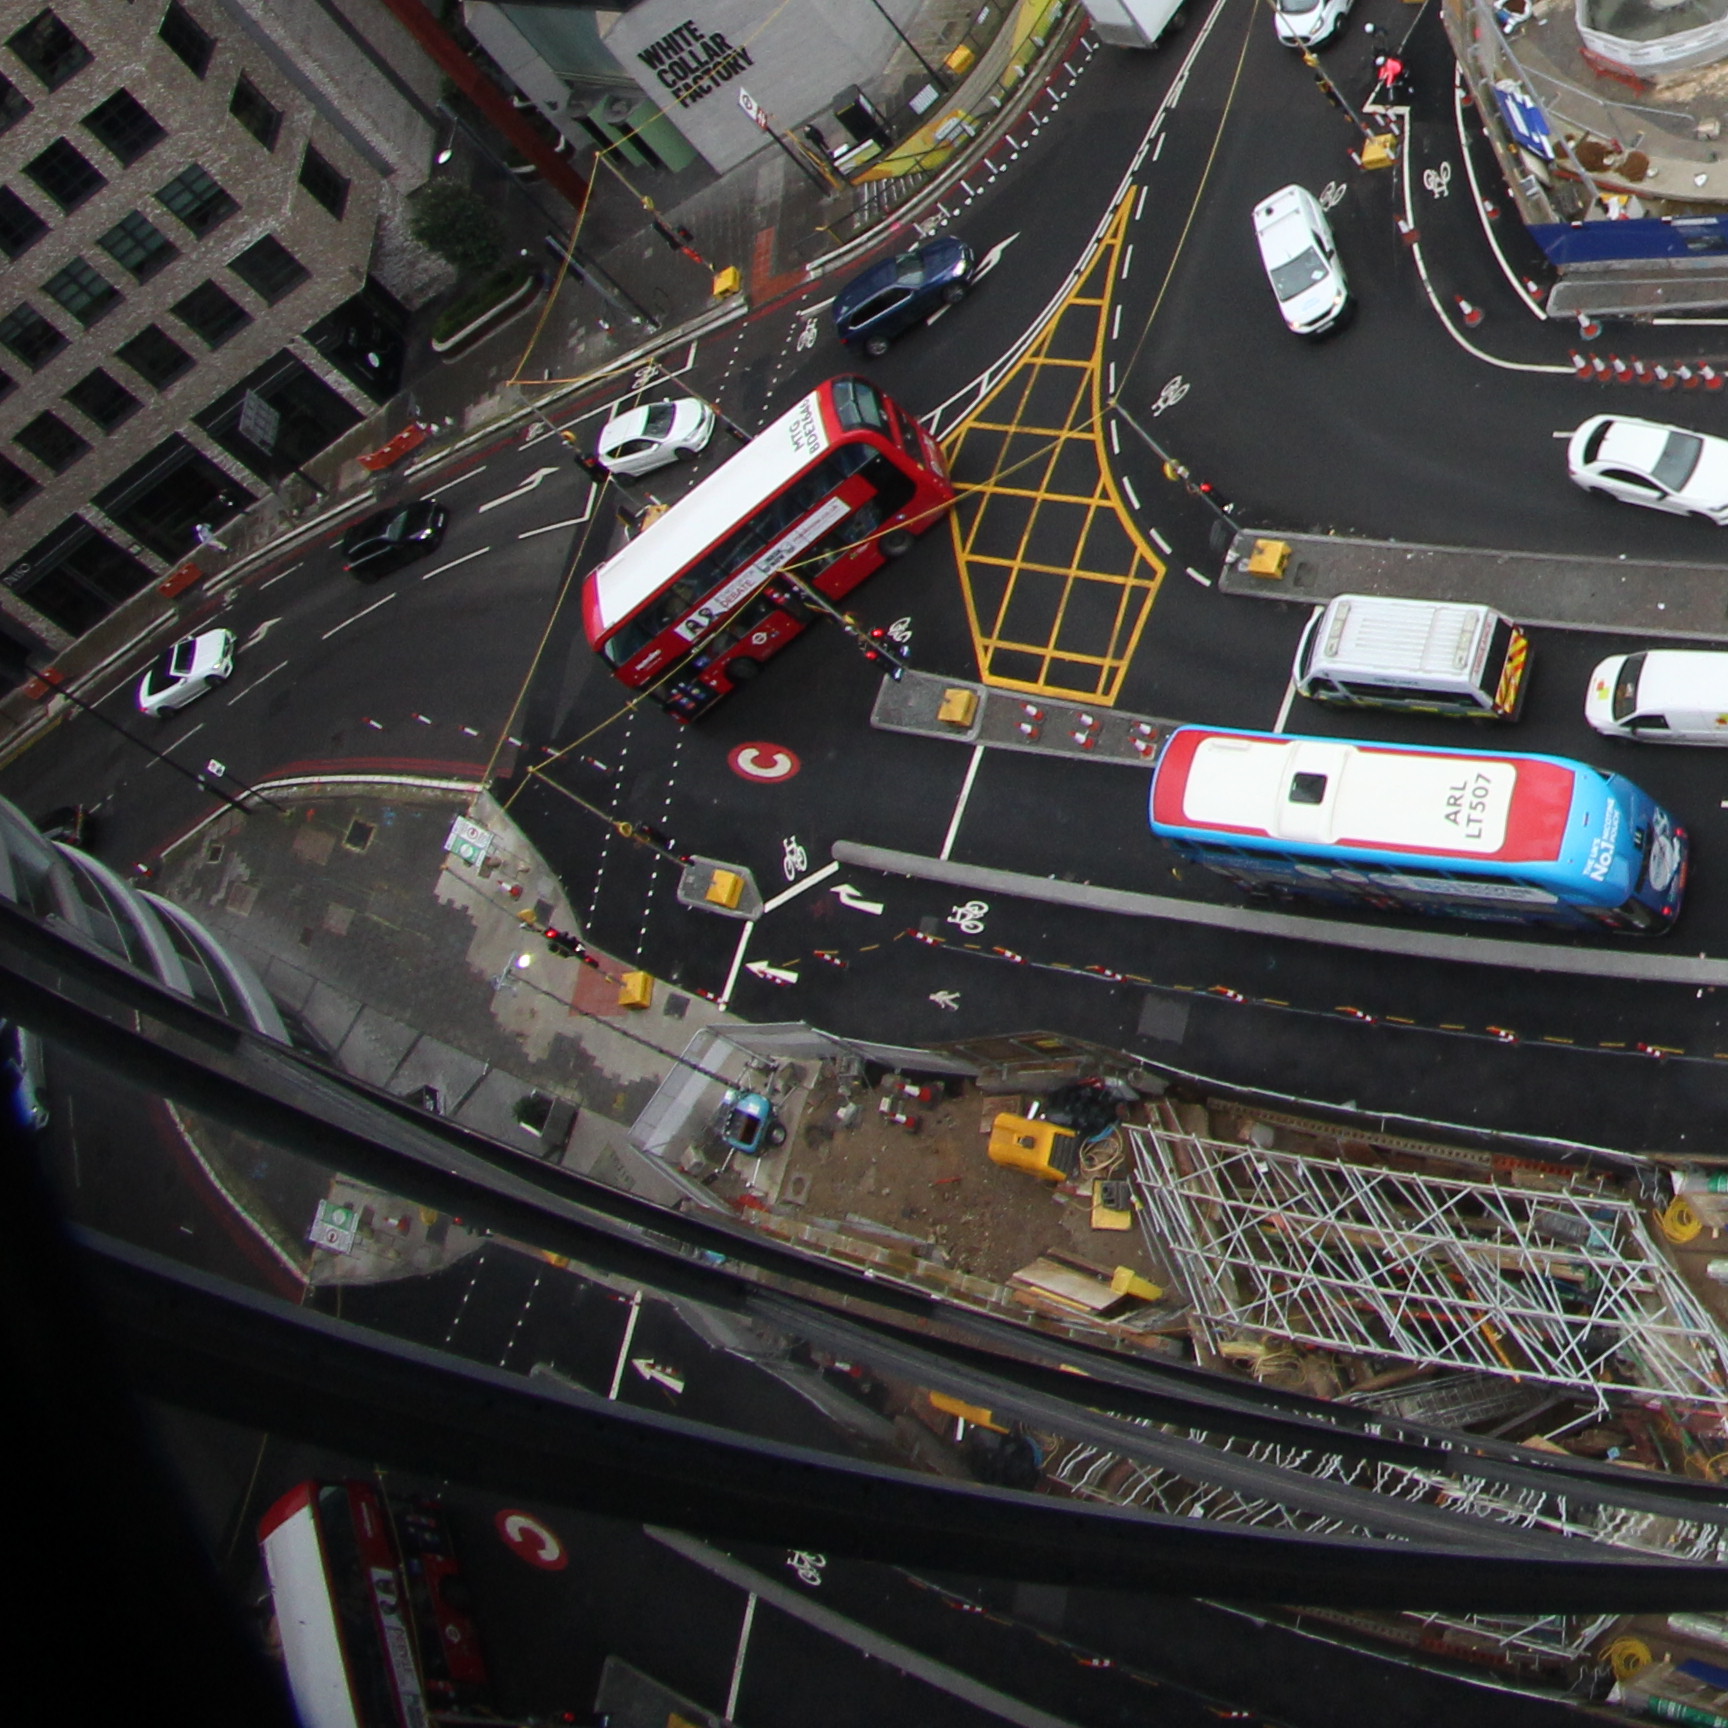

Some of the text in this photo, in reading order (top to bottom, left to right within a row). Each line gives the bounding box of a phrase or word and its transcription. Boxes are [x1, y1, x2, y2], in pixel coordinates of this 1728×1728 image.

[637, 19, 705, 70] WHITE
[656, 32, 733, 89] COLLAR
[670, 46, 755, 109] FACTORY
[720, 579, 756, 609] DEBATE
[1444, 780, 1468, 826] ARL
[1465, 773, 1492, 839] LT507
[1602, 797, 1615, 839] NICOTINE
[1609, 809, 1621, 843] POUCH
[1590, 838, 1615, 882] No.1
